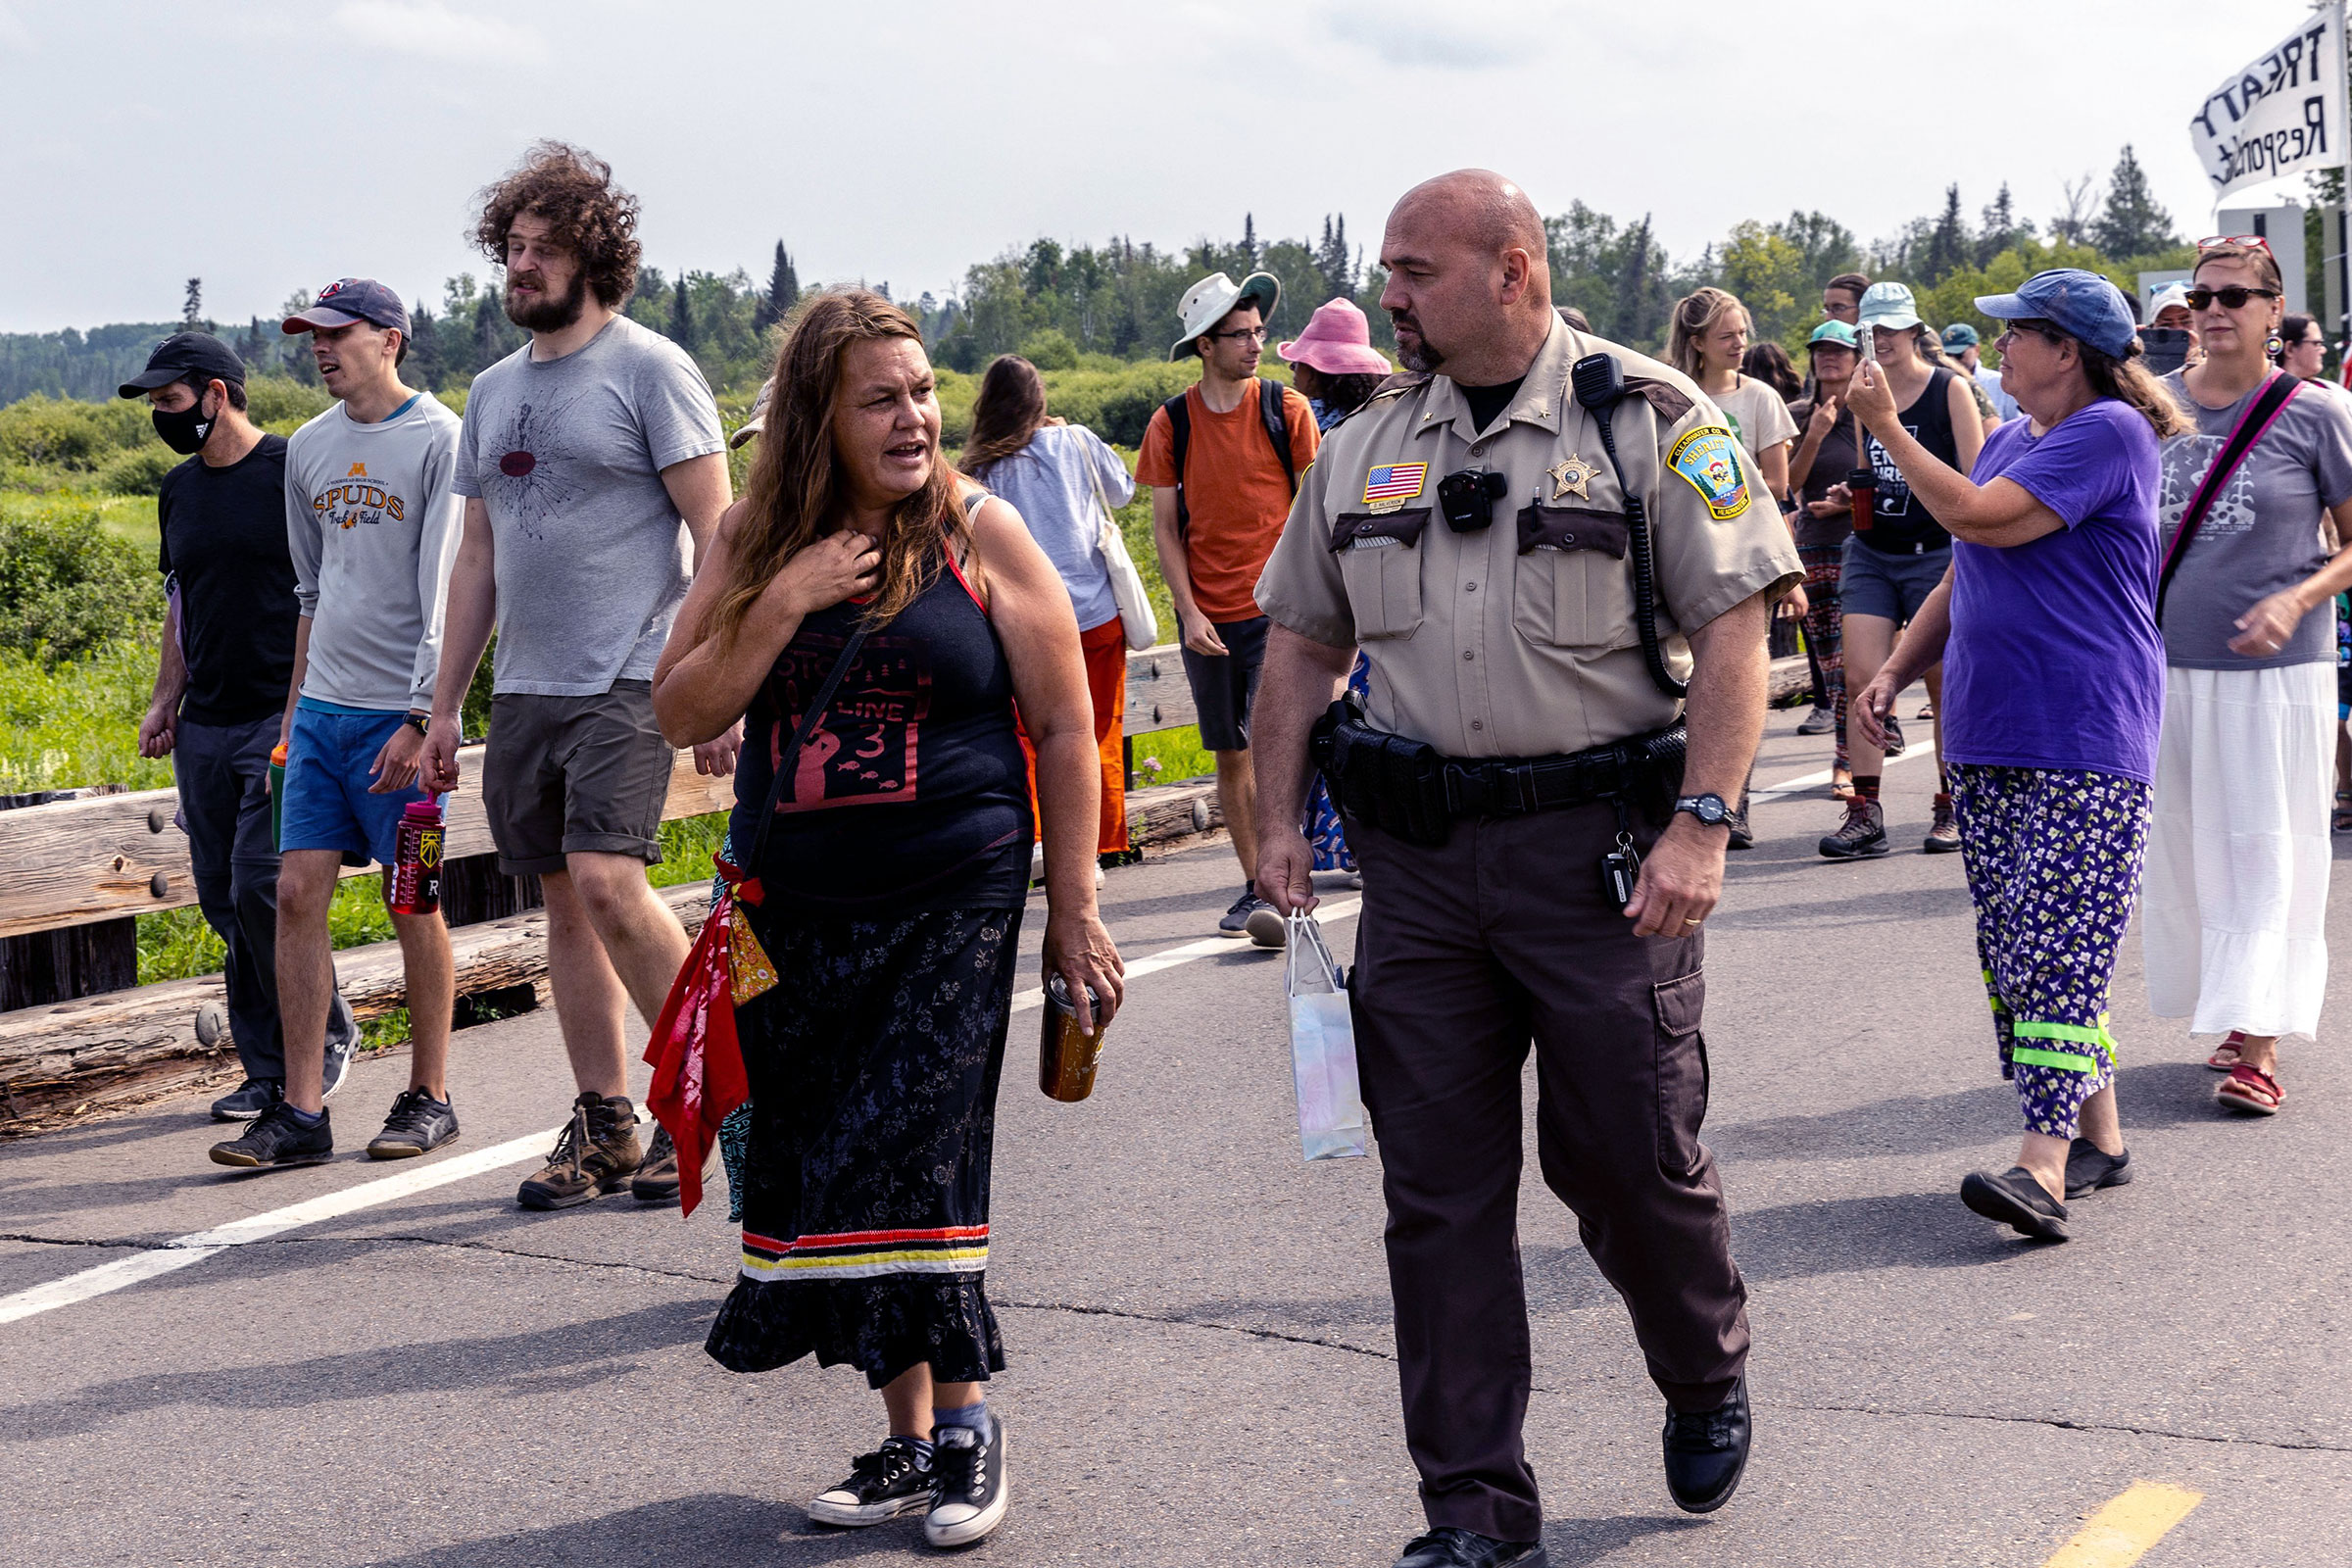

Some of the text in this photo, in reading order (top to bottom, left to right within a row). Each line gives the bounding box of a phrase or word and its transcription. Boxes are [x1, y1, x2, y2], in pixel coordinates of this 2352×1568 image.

[1674, 428, 1709, 456] CLEARWATER
[1684, 439, 1725, 466] SHERIFF
[313, 484, 405, 521] SPUDS
[359, 510, 381, 524] Field
[837, 702, 905, 721] LINE
[856, 723, 885, 759] 3
